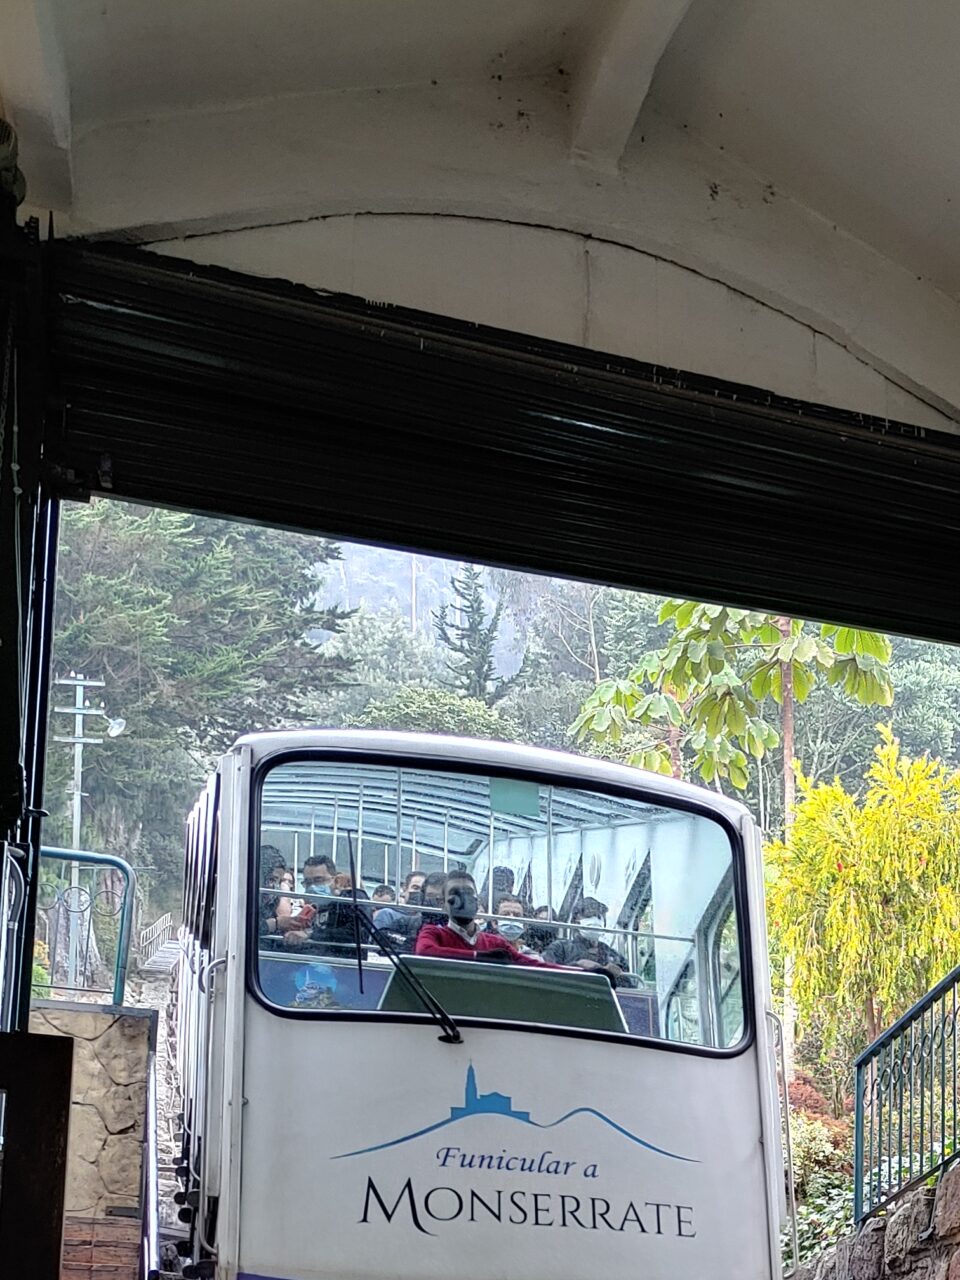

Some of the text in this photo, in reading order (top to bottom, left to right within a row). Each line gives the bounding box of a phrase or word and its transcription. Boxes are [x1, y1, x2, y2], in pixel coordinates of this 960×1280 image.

[435, 1146, 599, 1179] Funicular a
[358, 1175, 697, 1239] MONSERRATE
